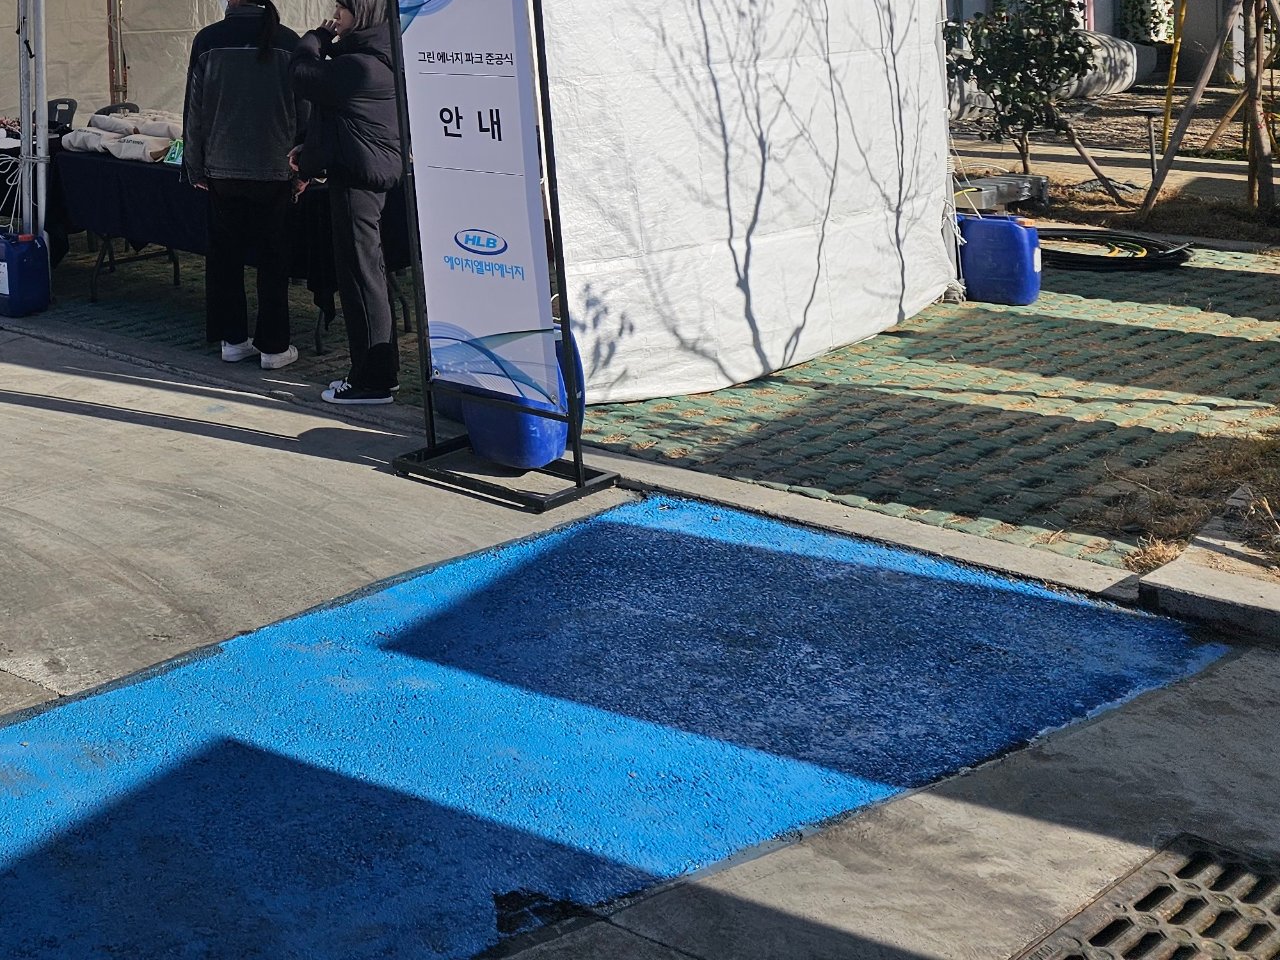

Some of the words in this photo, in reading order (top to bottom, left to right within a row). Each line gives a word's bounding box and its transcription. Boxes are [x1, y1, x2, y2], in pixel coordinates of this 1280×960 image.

[418, 51, 435, 64] 그린
[436, 51, 463, 65] 에너지
[464, 52, 483, 65] 파크
[485, 52, 513, 66] 준공식
[439, 106, 463, 138] 안
[478, 108, 502, 141] 내
[464, 234, 498, 249] HLB
[443, 255, 525, 281] 에이치엘비에너지
